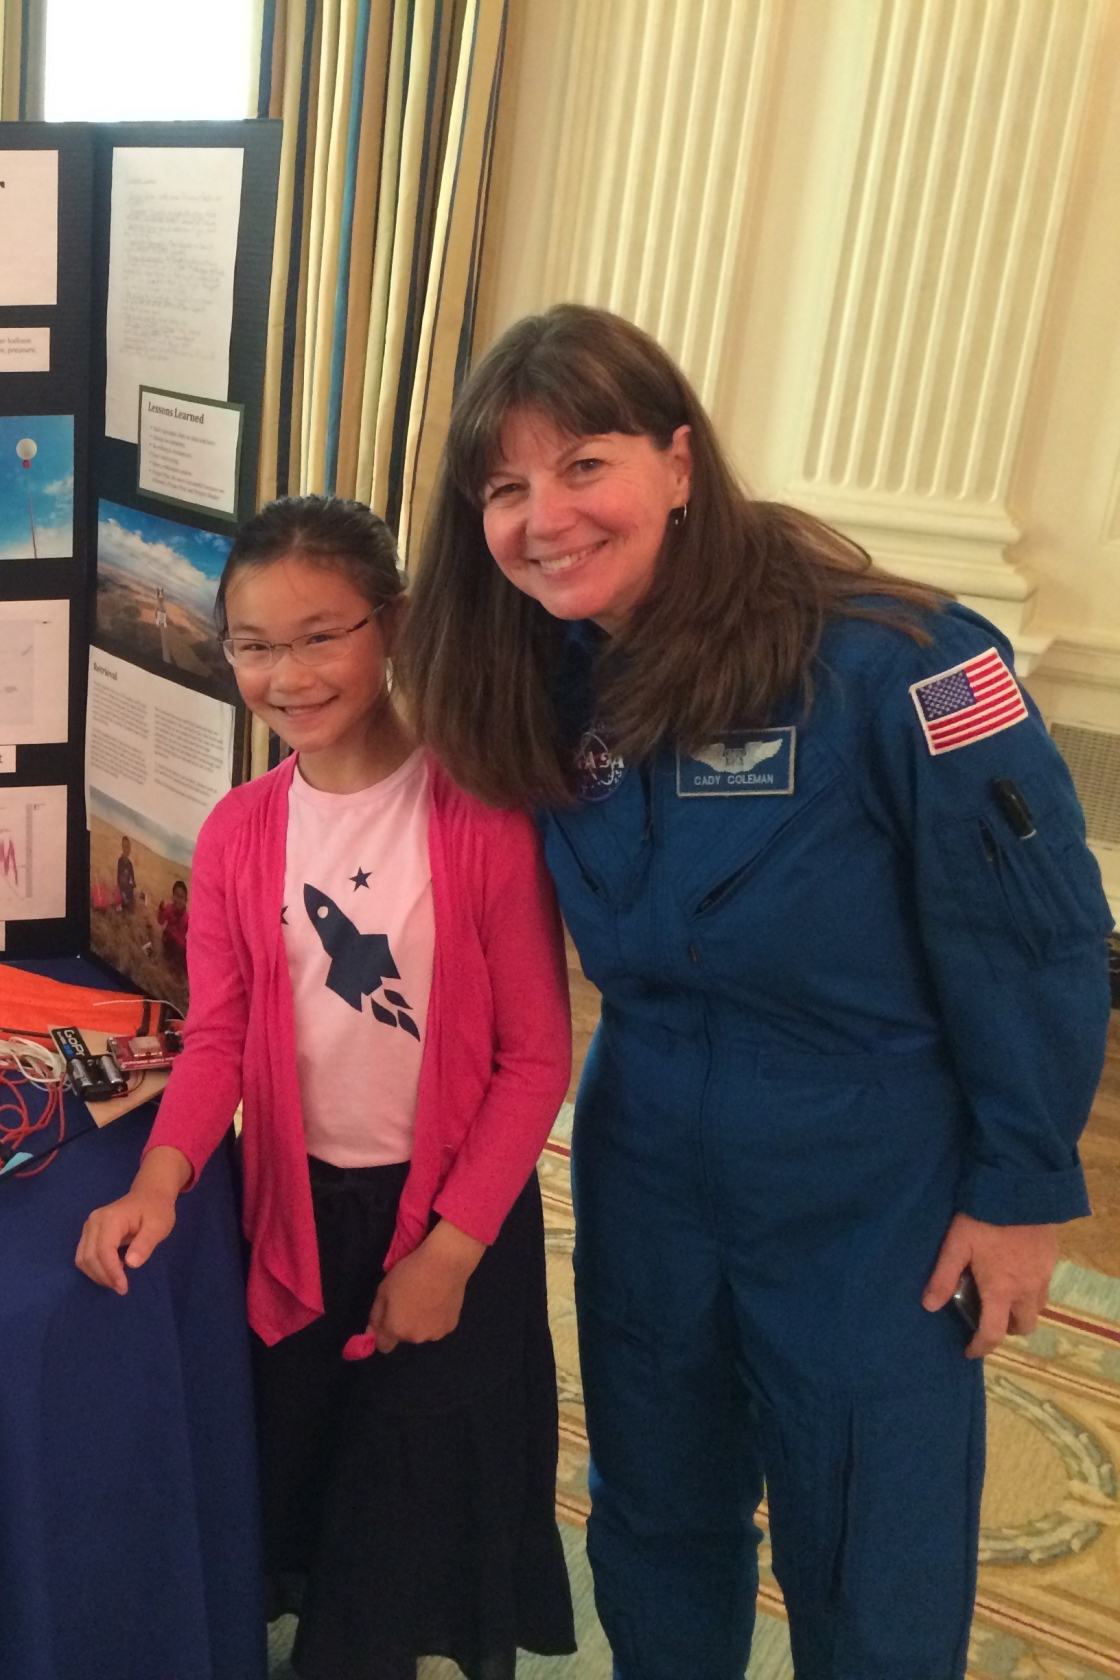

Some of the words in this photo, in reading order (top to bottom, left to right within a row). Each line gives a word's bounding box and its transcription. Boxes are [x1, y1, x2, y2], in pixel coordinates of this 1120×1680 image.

[148, 401, 174, 418] Lessons
[174, 407, 205, 424] Learned
[93, 662, 118, 681] Retrieval
[694, 775, 720, 786] CADY
[727, 774, 774, 785] COLEMAN
[63, 1029, 86, 1057] GoPr
